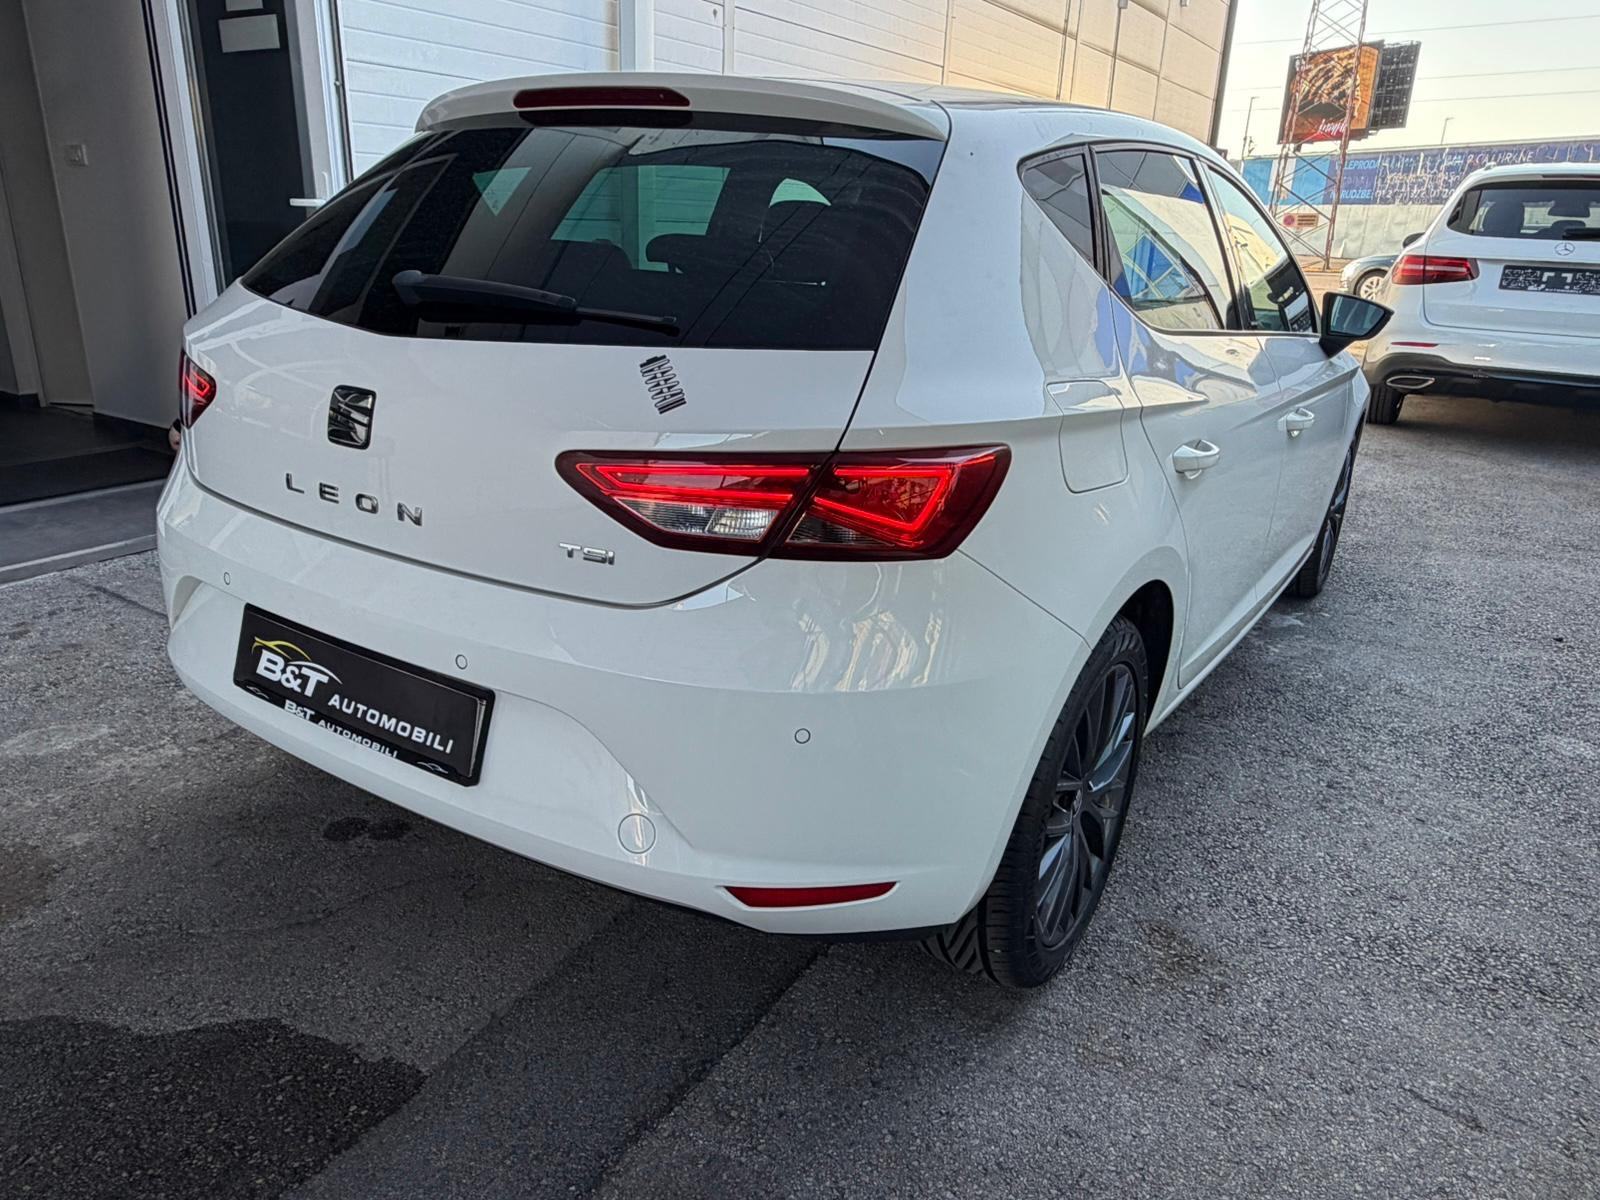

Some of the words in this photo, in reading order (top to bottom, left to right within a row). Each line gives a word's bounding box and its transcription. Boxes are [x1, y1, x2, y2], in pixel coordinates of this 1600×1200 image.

[1330, 187, 1373, 200] NRUDŽBE:
[285, 472, 423, 527] LEON
[558, 542, 616, 566] TSI
[255, 649, 329, 698] B&T
[327, 693, 454, 755] AUTOMOBILI
[284, 699, 315, 722] B&T
[317, 718, 399, 760] AUTOMOBILI
